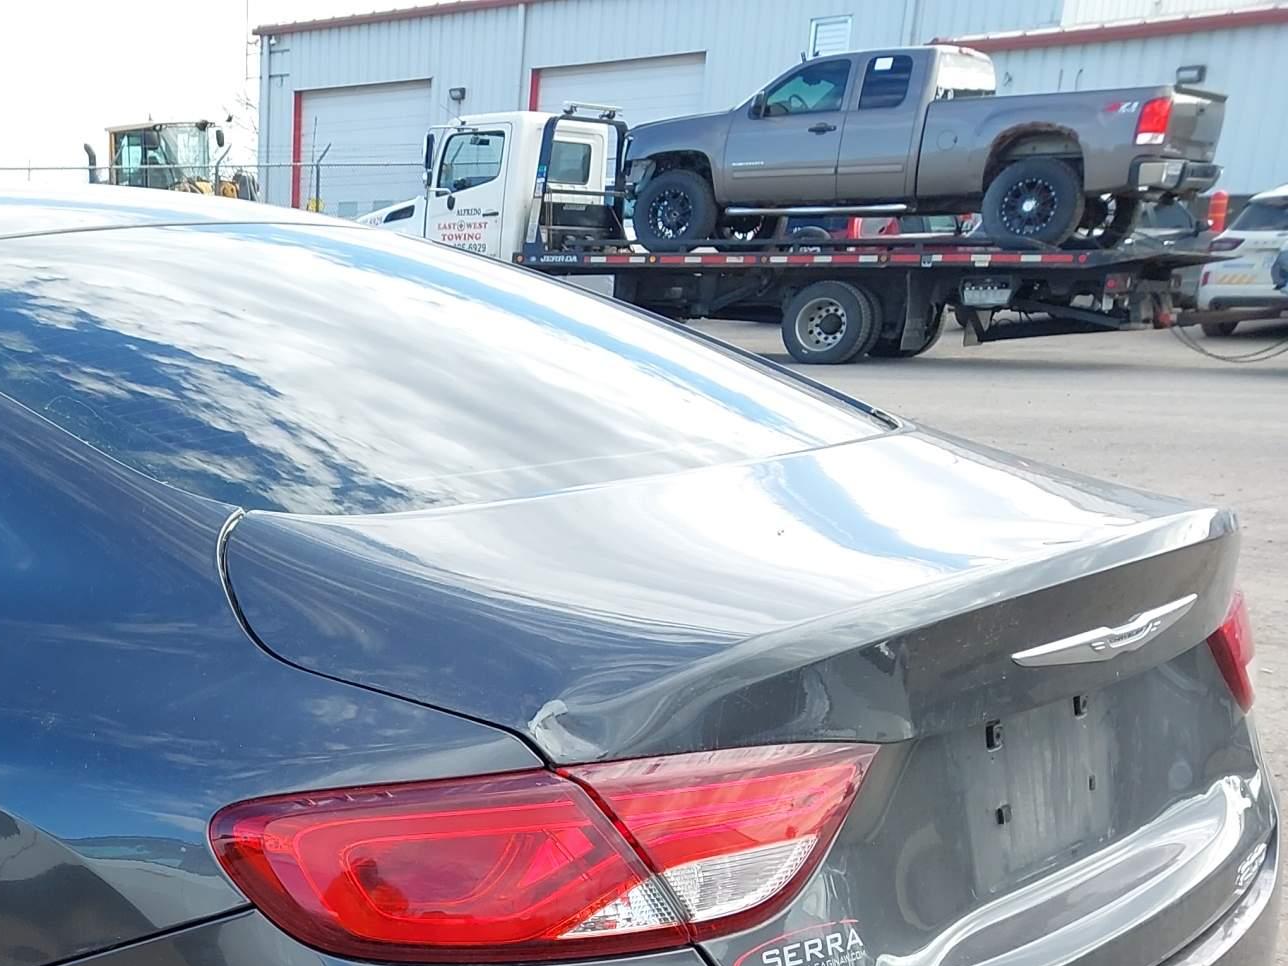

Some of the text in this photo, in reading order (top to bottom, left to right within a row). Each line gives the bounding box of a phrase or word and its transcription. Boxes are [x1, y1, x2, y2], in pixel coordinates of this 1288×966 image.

[437, 221, 488, 231] EAST WEST
[441, 232, 482, 241] TOWING
